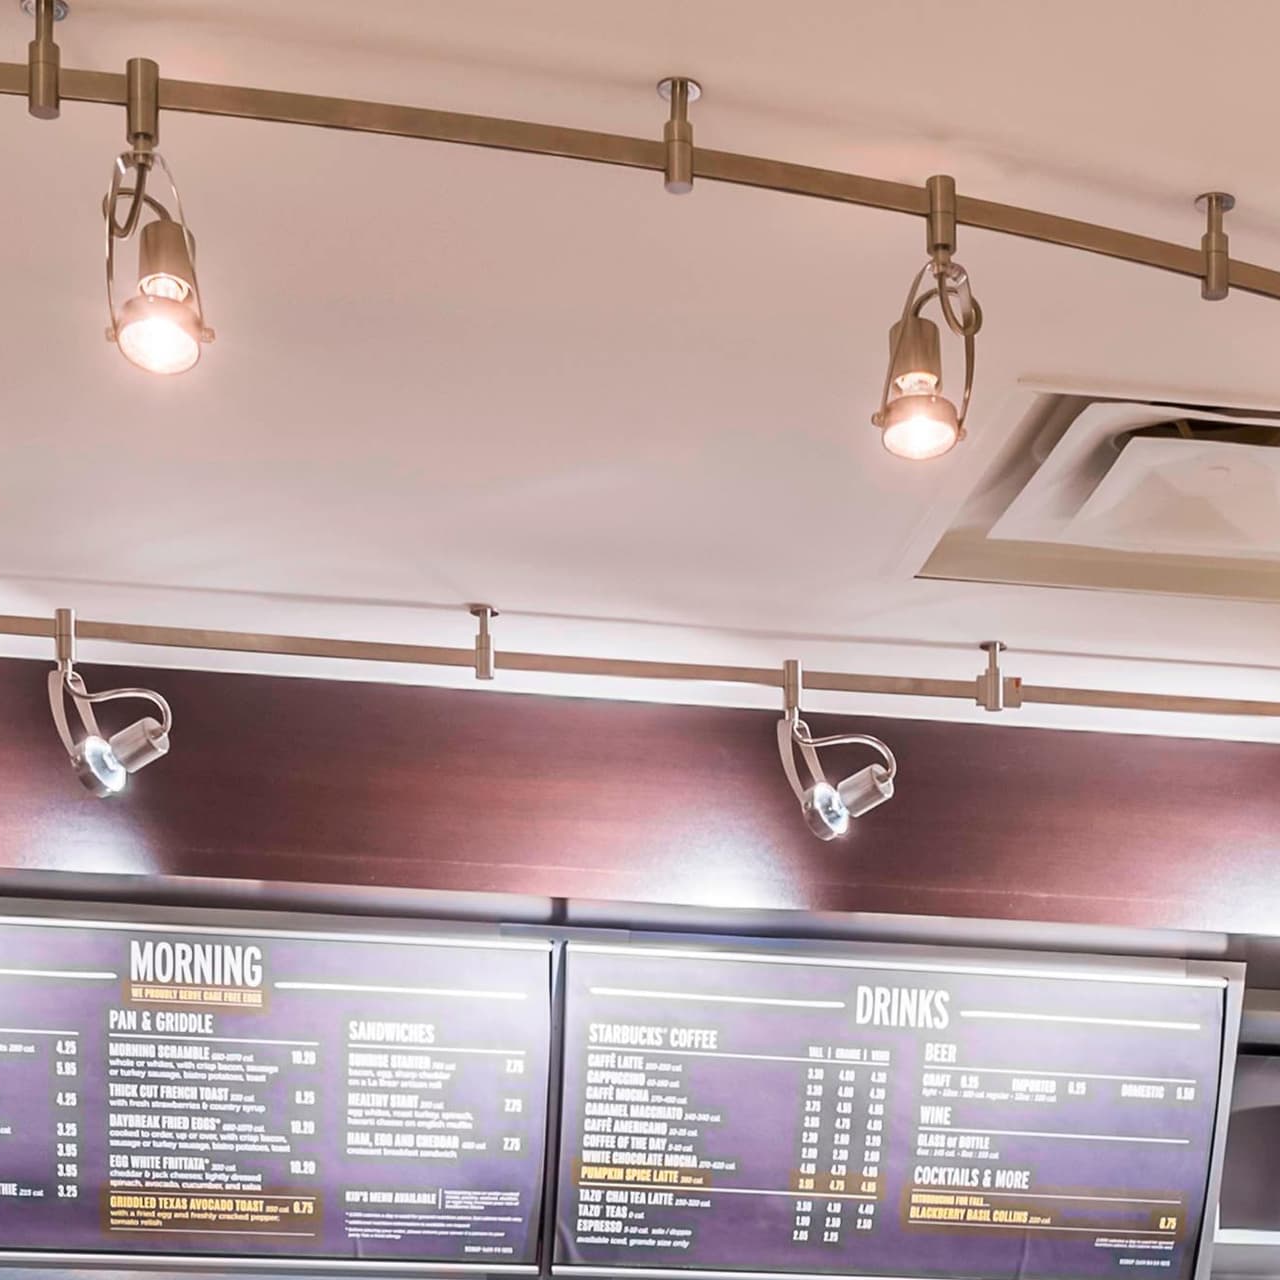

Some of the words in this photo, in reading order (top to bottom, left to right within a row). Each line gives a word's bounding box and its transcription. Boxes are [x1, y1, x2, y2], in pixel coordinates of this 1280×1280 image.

[130, 940, 263, 987] MORNING
[856, 985, 950, 1030] DRINKS
[109, 1010, 138, 1031] PAN
[141, 1011, 152, 1031] &
[156, 1012, 213, 1034] GRIDDLE
[348, 1020, 435, 1043] SANDWICHES
[669, 1027, 718, 1050] COFFEE
[617, 1055, 645, 1071] LATTE
[924, 1043, 957, 1063] BEER
[139, 1084, 158, 1099] CUT
[160, 1085, 197, 1100] FRENCH
[199, 1086, 229, 1101] TOAST
[920, 1105, 952, 1126] WINE
[583, 1134, 615, 1149] COFFEE
[616, 1135, 628, 1149] OF
[629, 1136, 646, 1150] THE
[648, 1137, 667, 1151] DAY
[625, 1167, 652, 1182] SPICE
[653, 1169, 679, 1183] LATTE
[914, 1166, 980, 1187] COCKTAILS
[982, 1169, 991, 1187] &
[995, 1169, 1030, 1190] MORE
[110, 1196, 157, 1210] GRIDDLED
[158, 1197, 188, 1211] TEXAS
[189, 1198, 233, 1213] AVOCADO
[234, 1200, 264, 1214] TOAST
[605, 1205, 628, 1219] TEAS
[910, 1206, 965, 1222] BLACKBERRY
[966, 1208, 991, 1222] BASIL
[992, 1210, 1028, 1225] COLLINS
